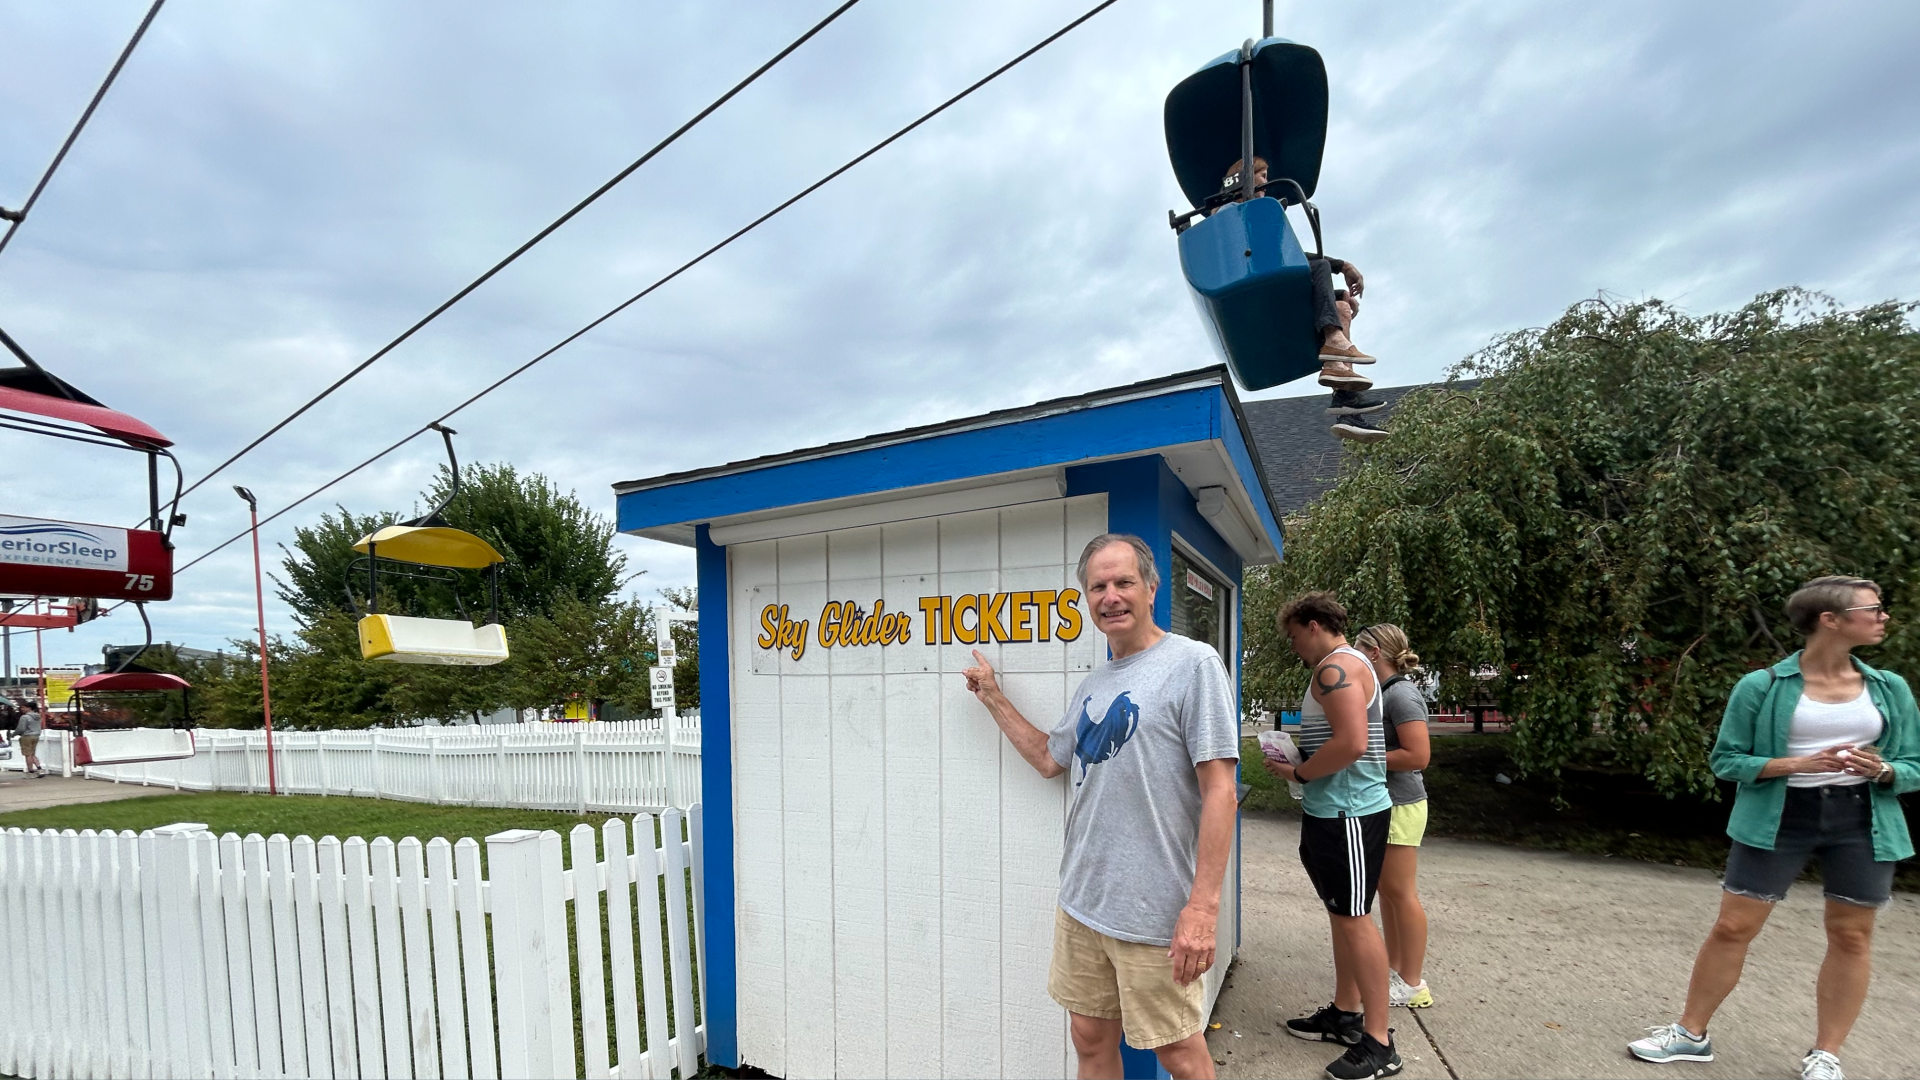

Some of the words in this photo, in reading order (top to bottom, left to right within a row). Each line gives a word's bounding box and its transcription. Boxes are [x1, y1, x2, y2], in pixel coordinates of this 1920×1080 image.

[0, 538, 117, 561] eriorSleep
[0, 554, 82, 566] XPERIENCE
[124, 573, 155, 591] 75
[758, 604, 809, 661] Sky
[817, 599, 911, 648] Glider
[919, 588, 1083, 645] TICKETS
